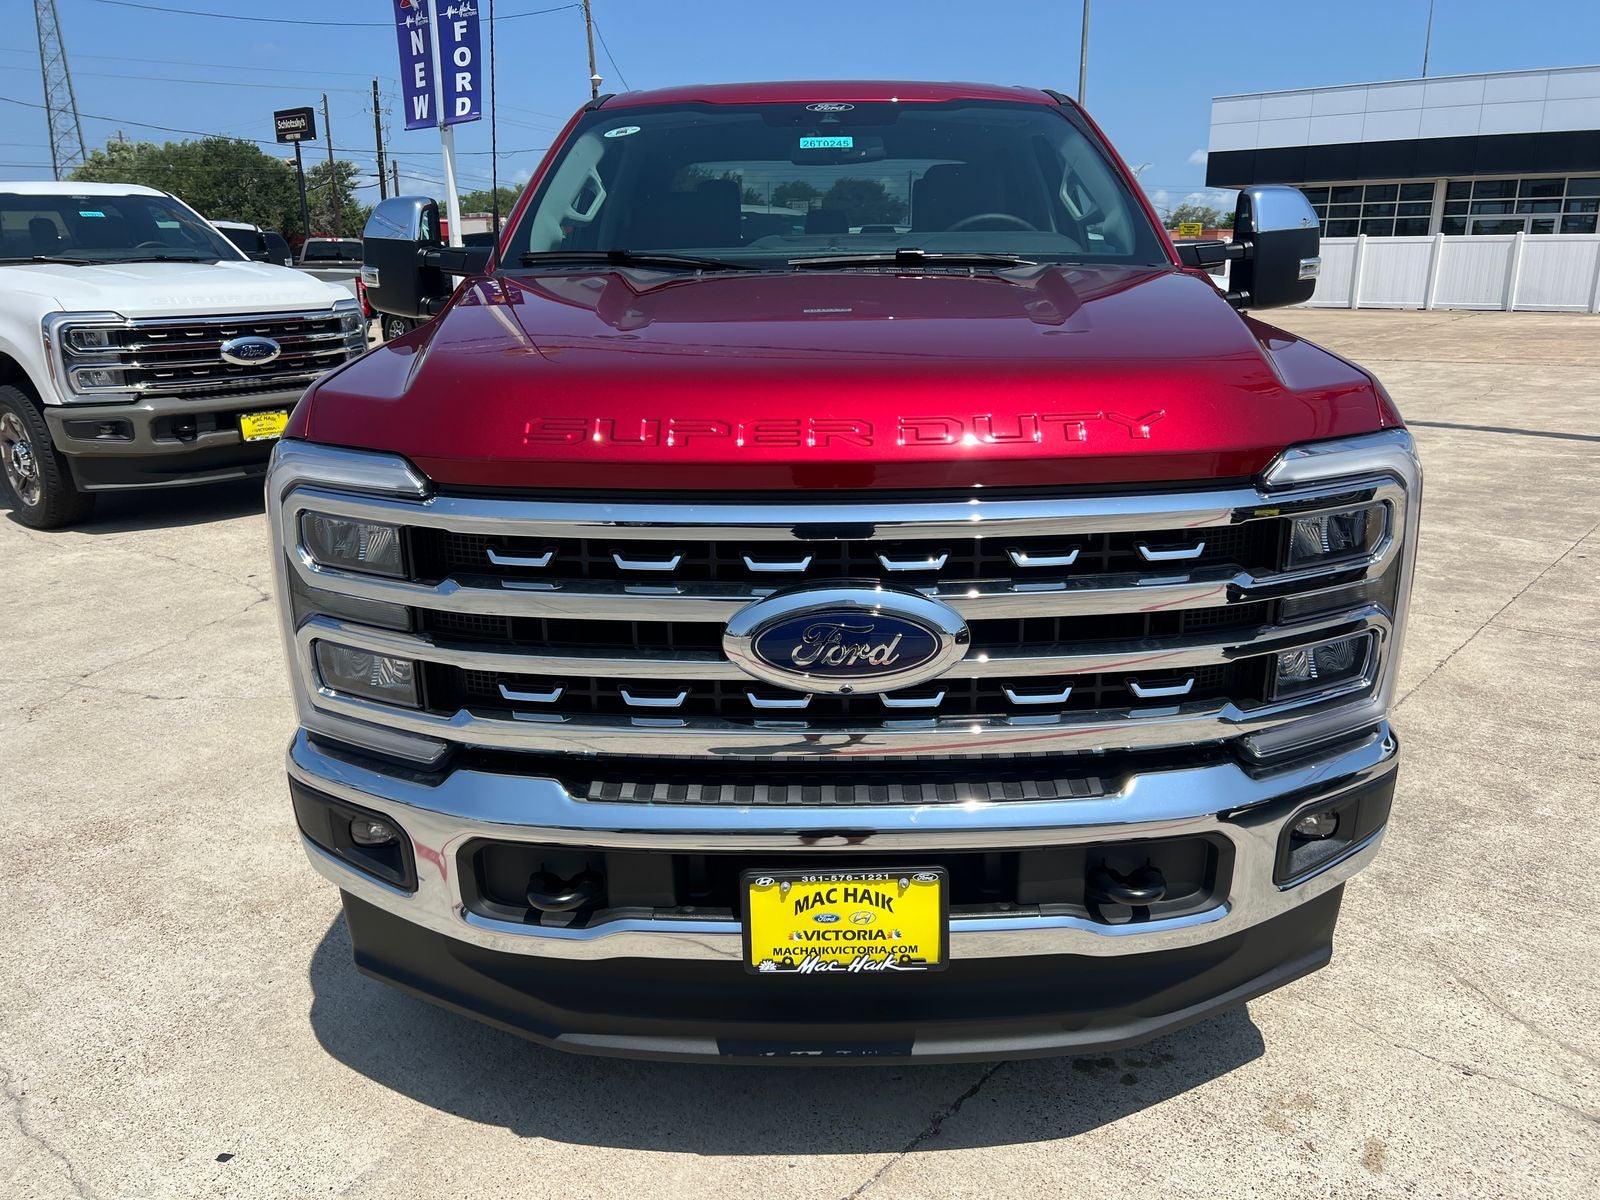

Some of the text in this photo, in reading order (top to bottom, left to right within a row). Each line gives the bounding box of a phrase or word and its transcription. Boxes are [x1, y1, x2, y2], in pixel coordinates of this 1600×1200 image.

[410, 29, 429, 120] NEW
[453, 21, 472, 117] FORD
[803, 139, 850, 147] 26T0245
[523, 409, 1165, 448] SUPER DUTY
[791, 623, 902, 666] Ford
[801, 874, 889, 882] 361-576-1221
[794, 887, 894, 916] MAC HAIK
[803, 929, 887, 941] VICTORIA
[773, 945, 918, 956] MACHAIKVICTORIA.COM
[797, 954, 917, 974] Mac Haik
